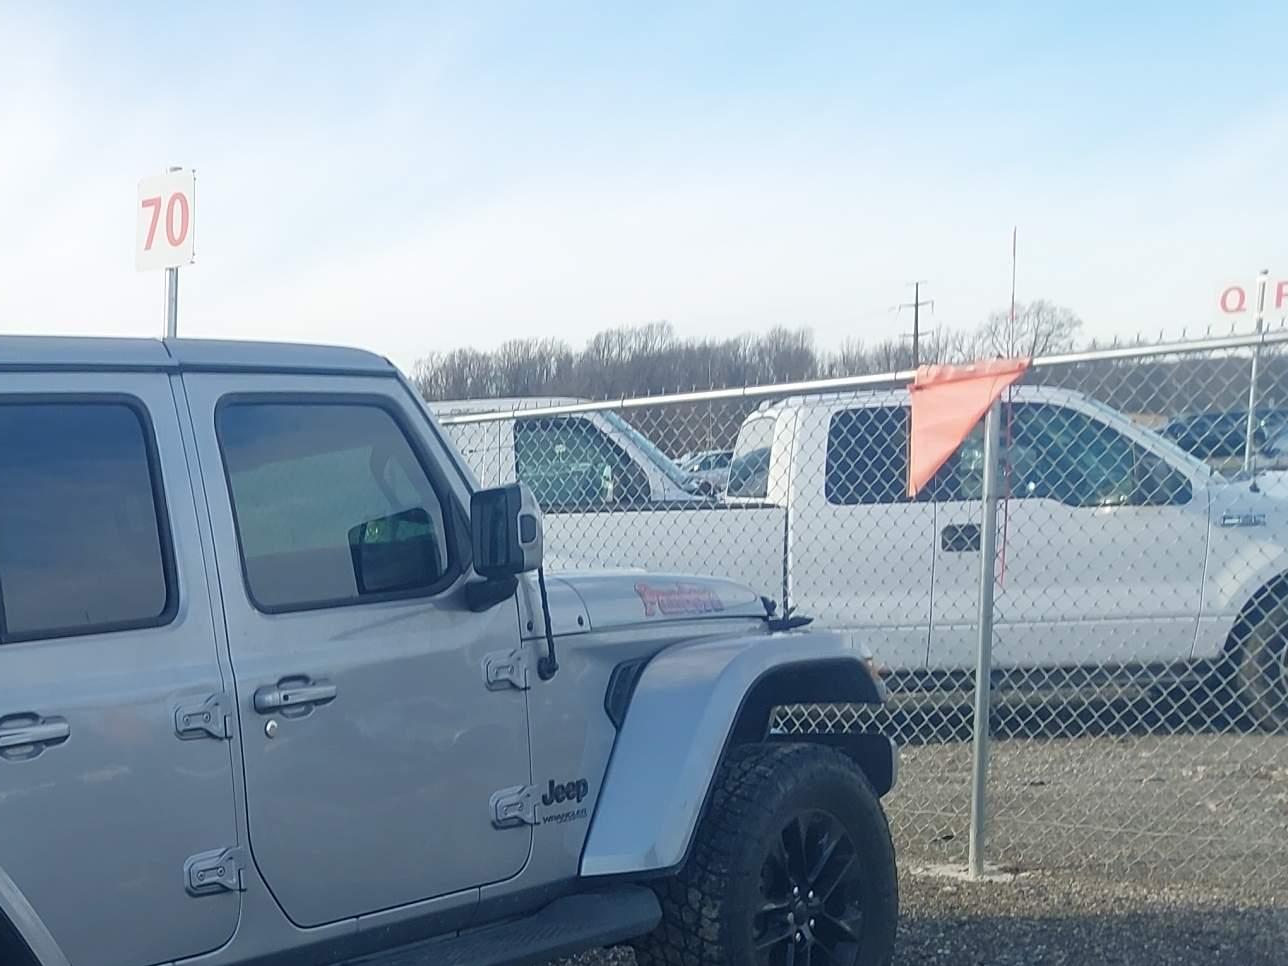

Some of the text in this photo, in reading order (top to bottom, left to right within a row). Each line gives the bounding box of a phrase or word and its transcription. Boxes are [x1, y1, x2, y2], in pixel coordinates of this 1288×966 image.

[141, 191, 190, 251] 70
[1220, 286, 1247, 314] Q
[541, 778, 589, 806] Jeep
